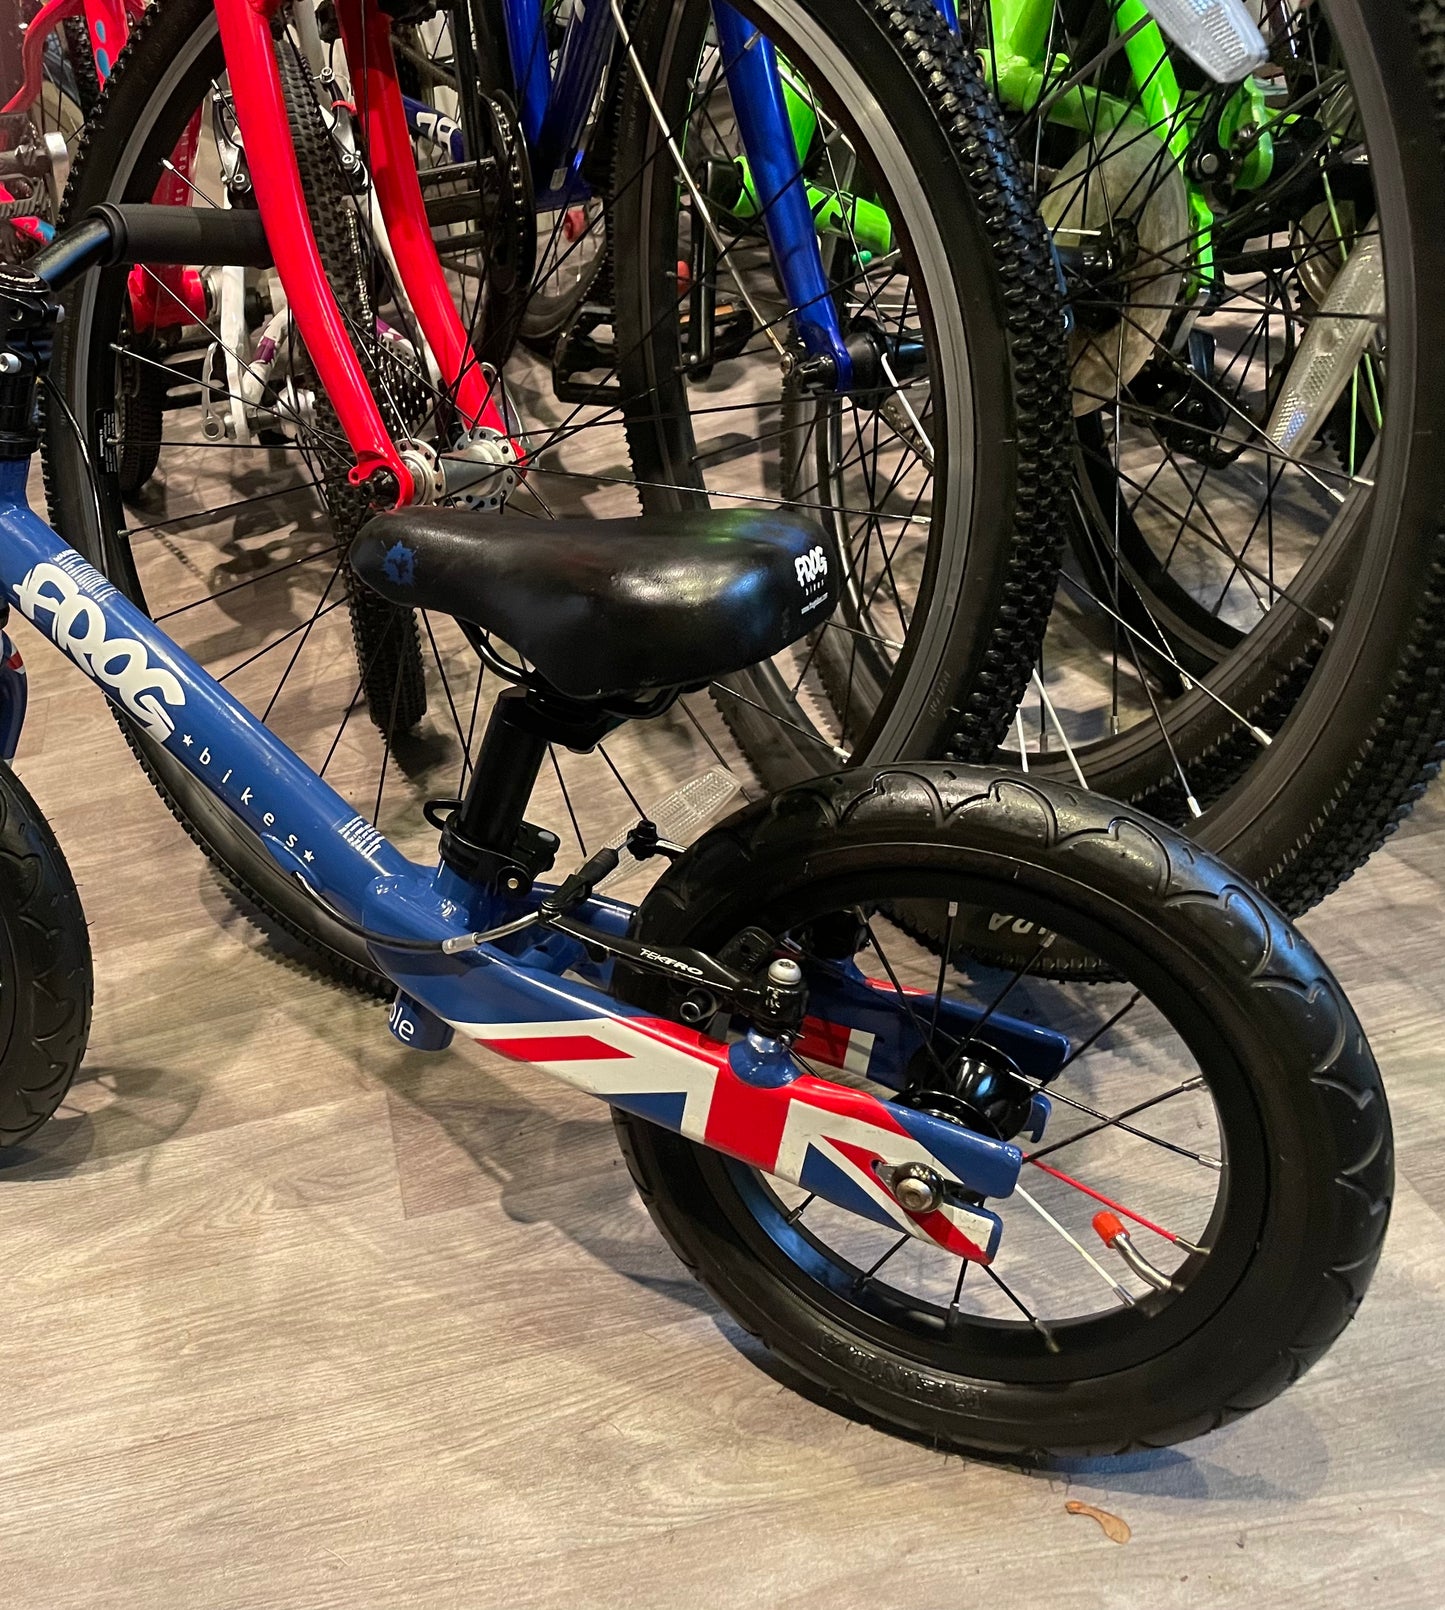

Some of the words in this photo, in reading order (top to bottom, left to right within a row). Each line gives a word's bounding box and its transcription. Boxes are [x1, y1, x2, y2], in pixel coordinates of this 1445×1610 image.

[794, 545, 828, 587] FROG
[12, 563, 186, 743] FROG
[199, 747, 298, 848] bikes
[640, 948, 704, 976] TEKTRO
